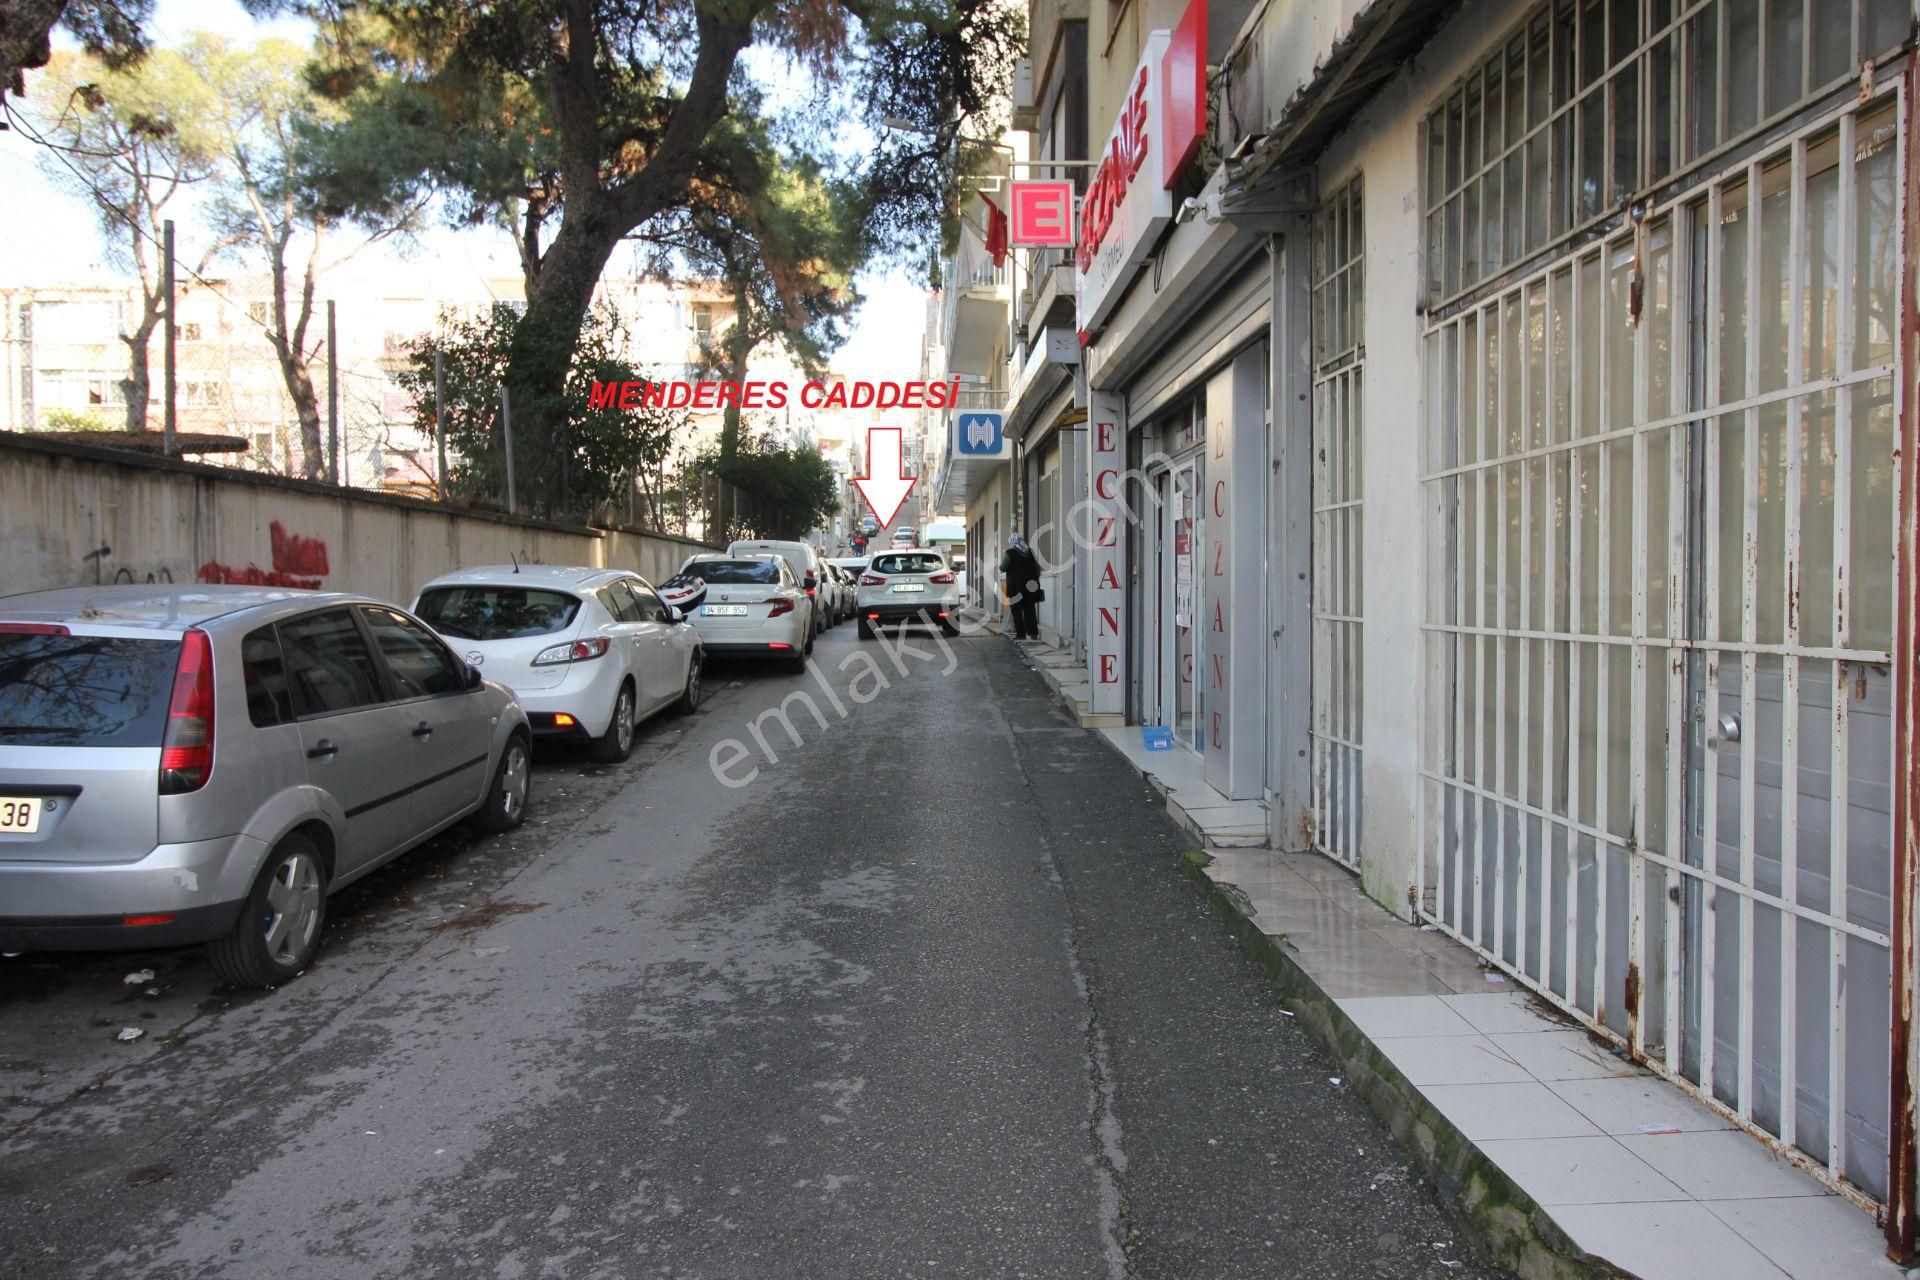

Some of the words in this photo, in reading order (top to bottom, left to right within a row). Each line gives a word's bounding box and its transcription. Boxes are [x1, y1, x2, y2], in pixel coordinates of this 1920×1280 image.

[1021, 191, 1061, 237] E
[1095, 422, 1120, 684] ECZANE
[1213, 420, 1226, 750] ECZANE
[1, 802, 32, 827] 38
